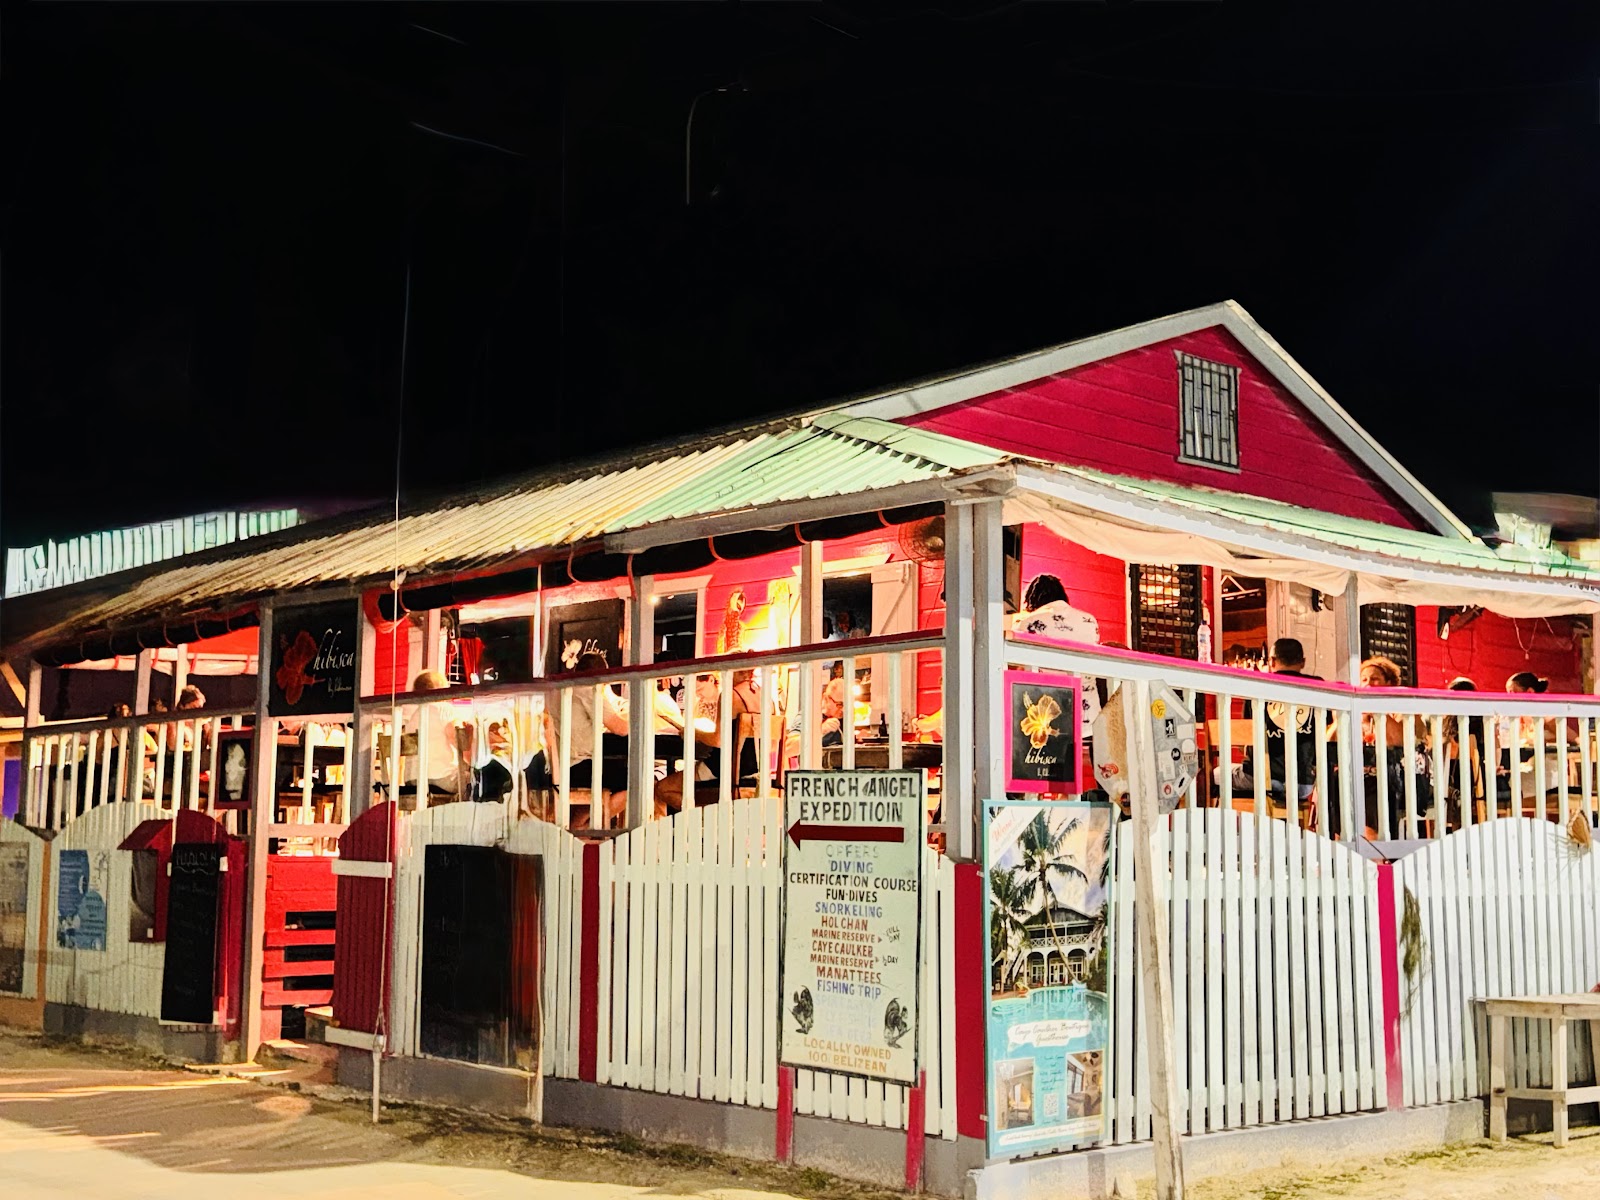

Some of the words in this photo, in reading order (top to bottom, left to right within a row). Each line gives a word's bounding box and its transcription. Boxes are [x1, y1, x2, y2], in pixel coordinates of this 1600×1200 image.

[791, 777, 859, 797] FRENCH
[867, 777, 917, 798] ANGEL
[800, 801, 903, 822] EXPEDITIOIN
[830, 860, 874, 874] DIVING
[790, 872, 869, 888] CERTIFICATION
[874, 877, 917, 892] COURSE
[815, 902, 883, 918] SNORKELING
[821, 915, 839, 928] HOL
[841, 917, 868, 931] CHAN
[812, 928, 841, 940] MARINE
[842, 930, 875, 943] RESERVE
[812, 940, 833, 954] CAYE
[835, 943, 873, 958] CAULKER
[810, 953, 839, 966] MARINE
[841, 956, 874, 969] RESERVE
[816, 965, 882, 984] MANATTEES
[817, 979, 855, 995] FISHING
[858, 984, 882, 1000] TRIP
[803, 1037, 852, 1054] LOCALLY
[854, 1045, 892, 1060] OWNED
[833, 1054, 887, 1073] BELIZEAN
